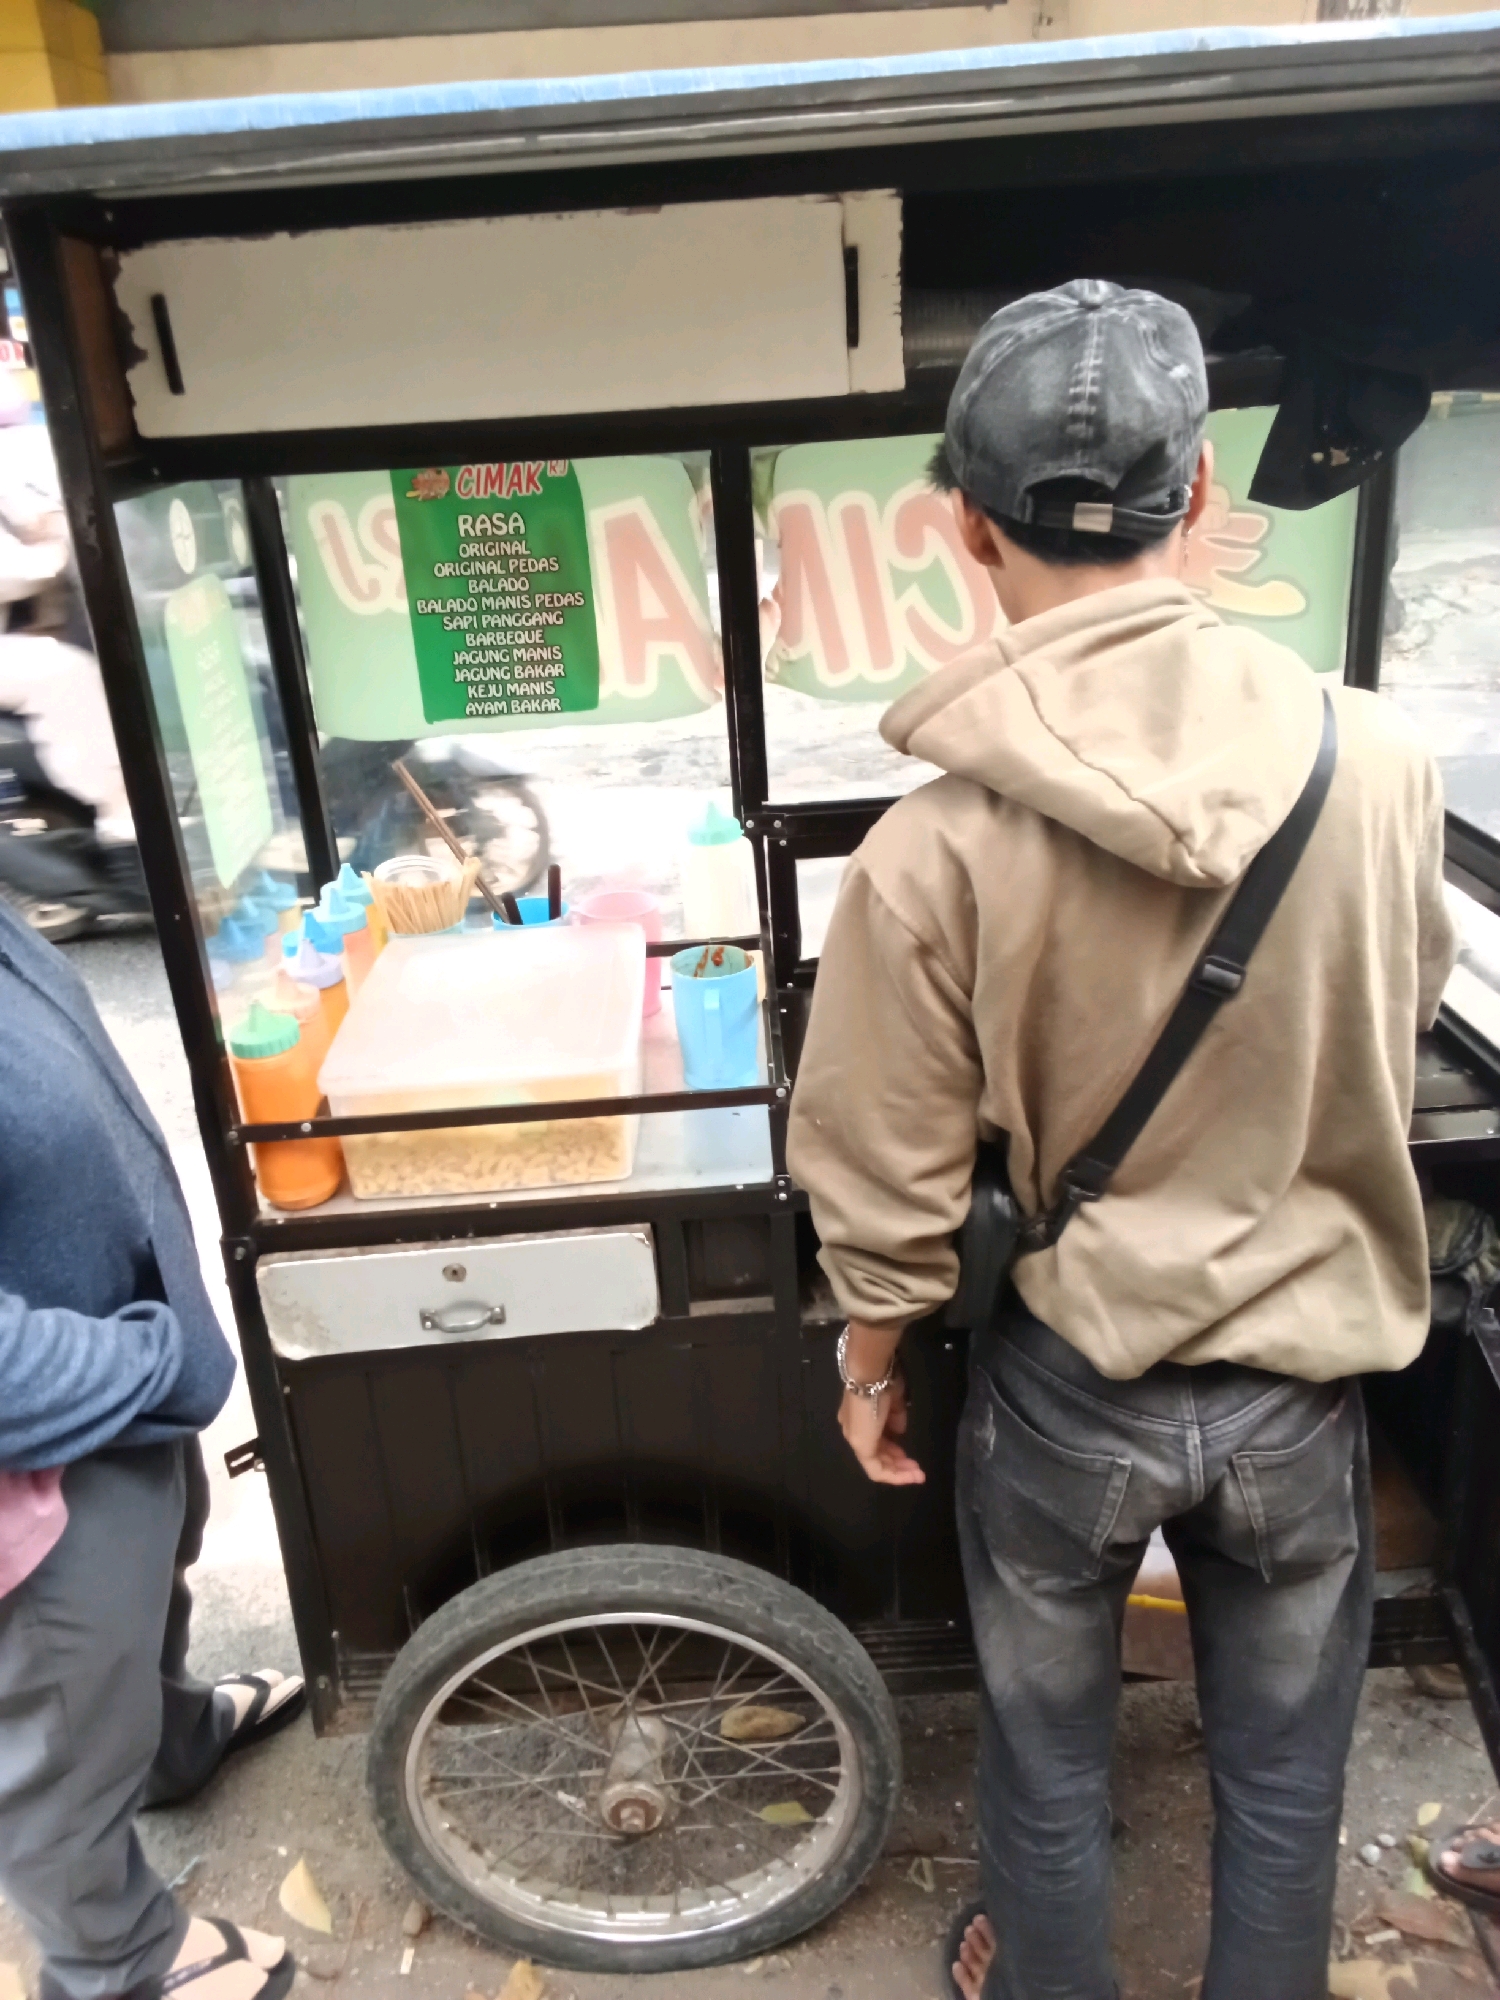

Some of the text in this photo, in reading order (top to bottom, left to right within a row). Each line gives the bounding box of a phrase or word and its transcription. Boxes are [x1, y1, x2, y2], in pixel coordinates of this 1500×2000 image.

[456, 462, 544, 499] CIMAK
[458, 512, 526, 537] RASA
[459, 540, 531, 558] ORIGINAL
[433, 557, 560, 578] ORIGINAL PEDAS
[468, 577, 530, 594] BALADO
[416, 592, 585, 614] BALADO MANIS PEDAS
[443, 611, 564, 631] SAPI PANGGANG
[465, 630, 545, 647] BARBEQUE
[453, 646, 562, 665] JAGUNG MANIS
[454, 663, 565, 682] JAGUNG BAKAR
[467, 681, 556, 698] KEJU MANIS
[465, 698, 561, 716] AYAM BAKAR
